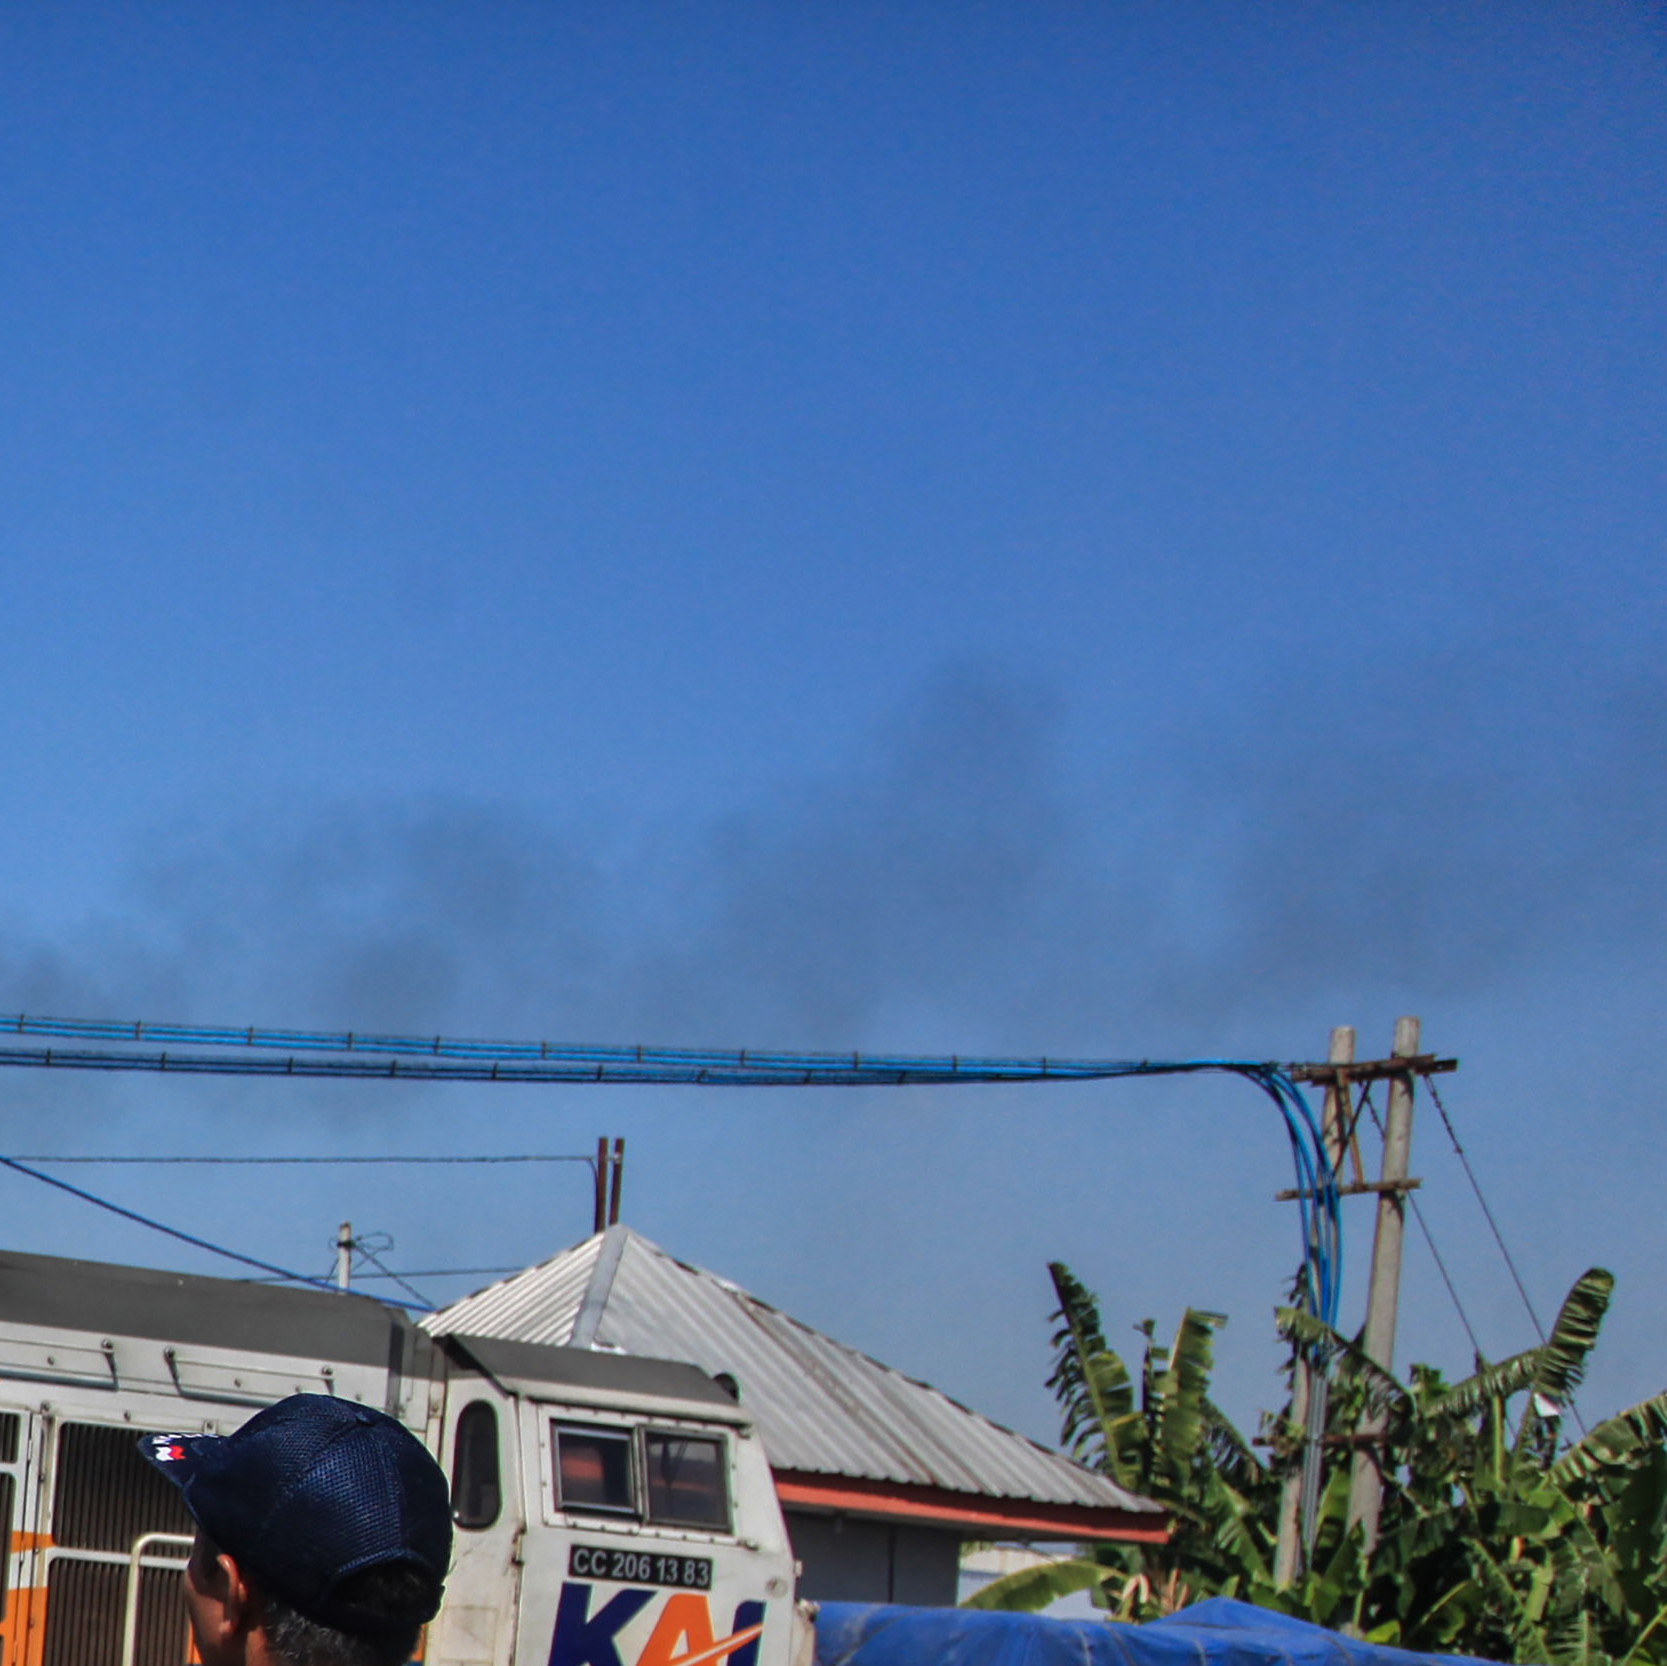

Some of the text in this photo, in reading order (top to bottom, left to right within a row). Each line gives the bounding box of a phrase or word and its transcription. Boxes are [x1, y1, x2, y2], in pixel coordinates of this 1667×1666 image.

[573, 1548, 709, 1586] CC 206 13 83
